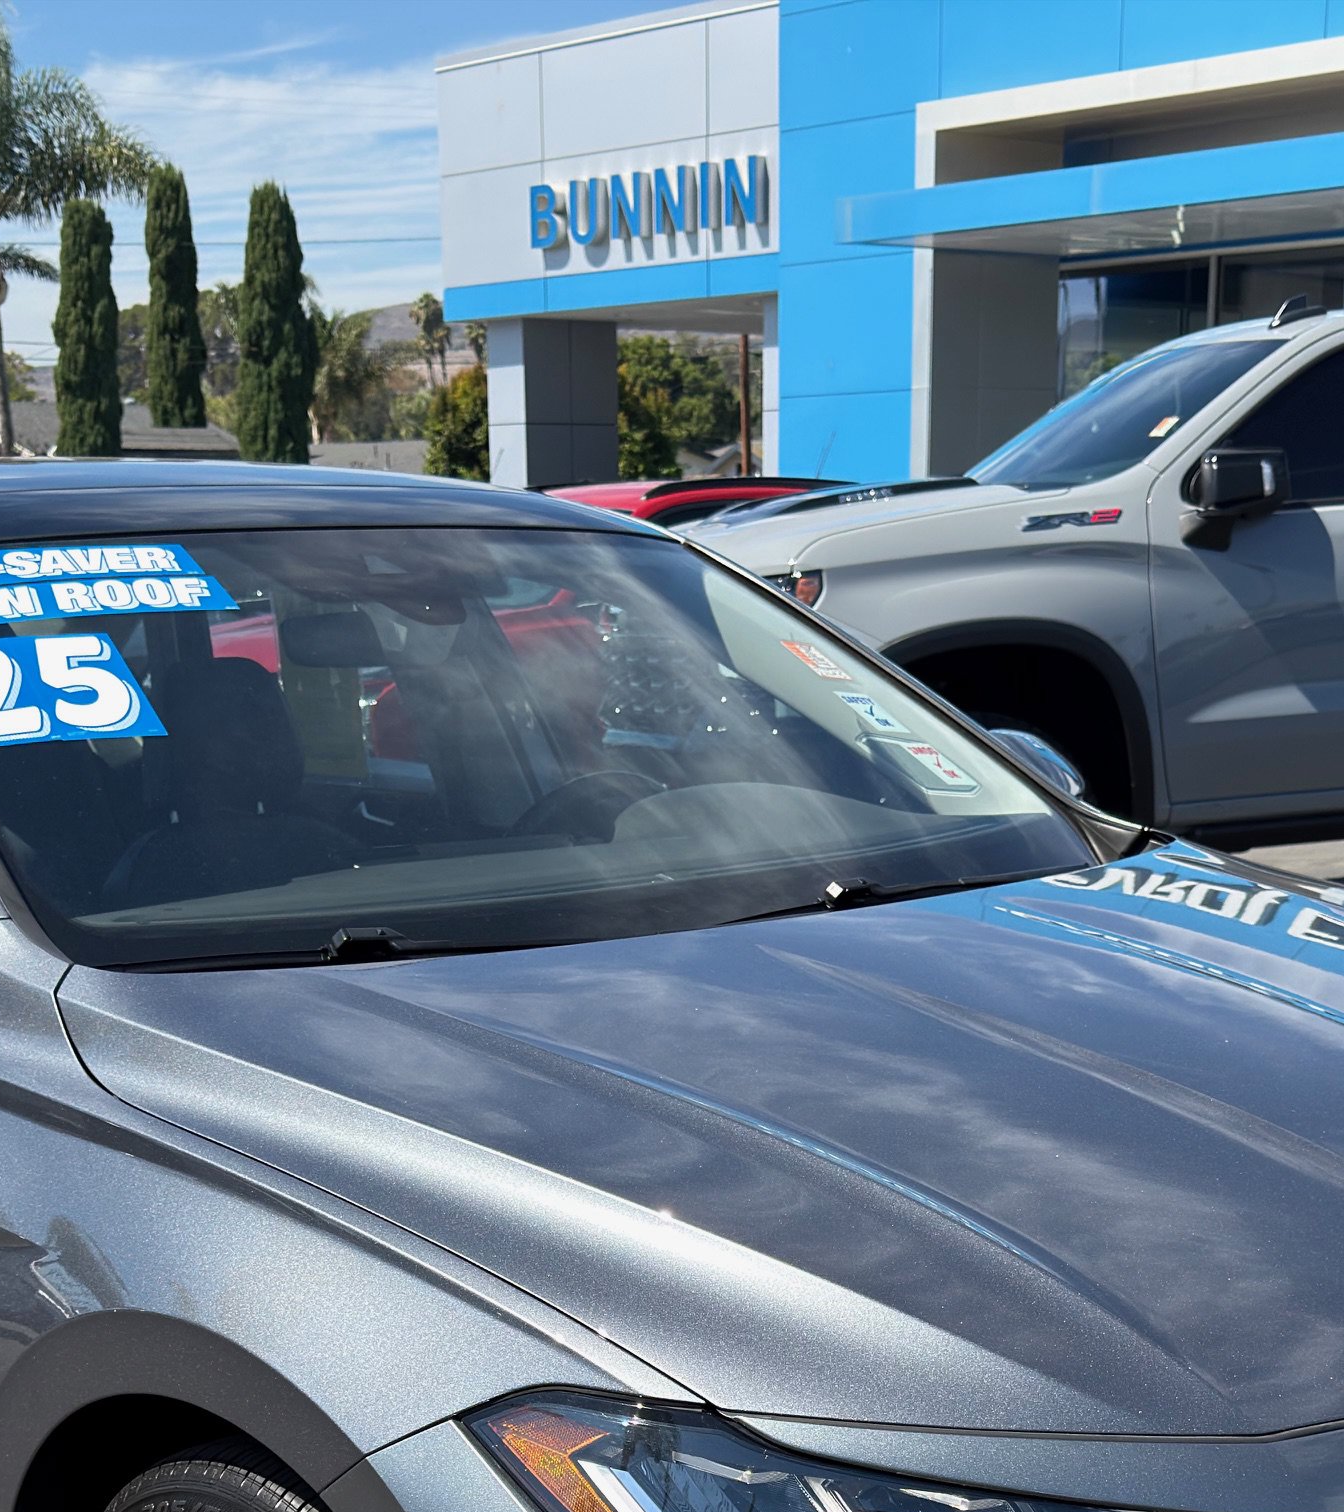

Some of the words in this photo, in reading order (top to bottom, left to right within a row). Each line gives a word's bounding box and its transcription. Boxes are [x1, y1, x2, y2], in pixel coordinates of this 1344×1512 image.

[530, 154, 770, 249] BUNNIN
[51, 578, 211, 612] ROOF
[841, 695, 875, 706] SAFETY
[875, 718, 894, 728] OK
